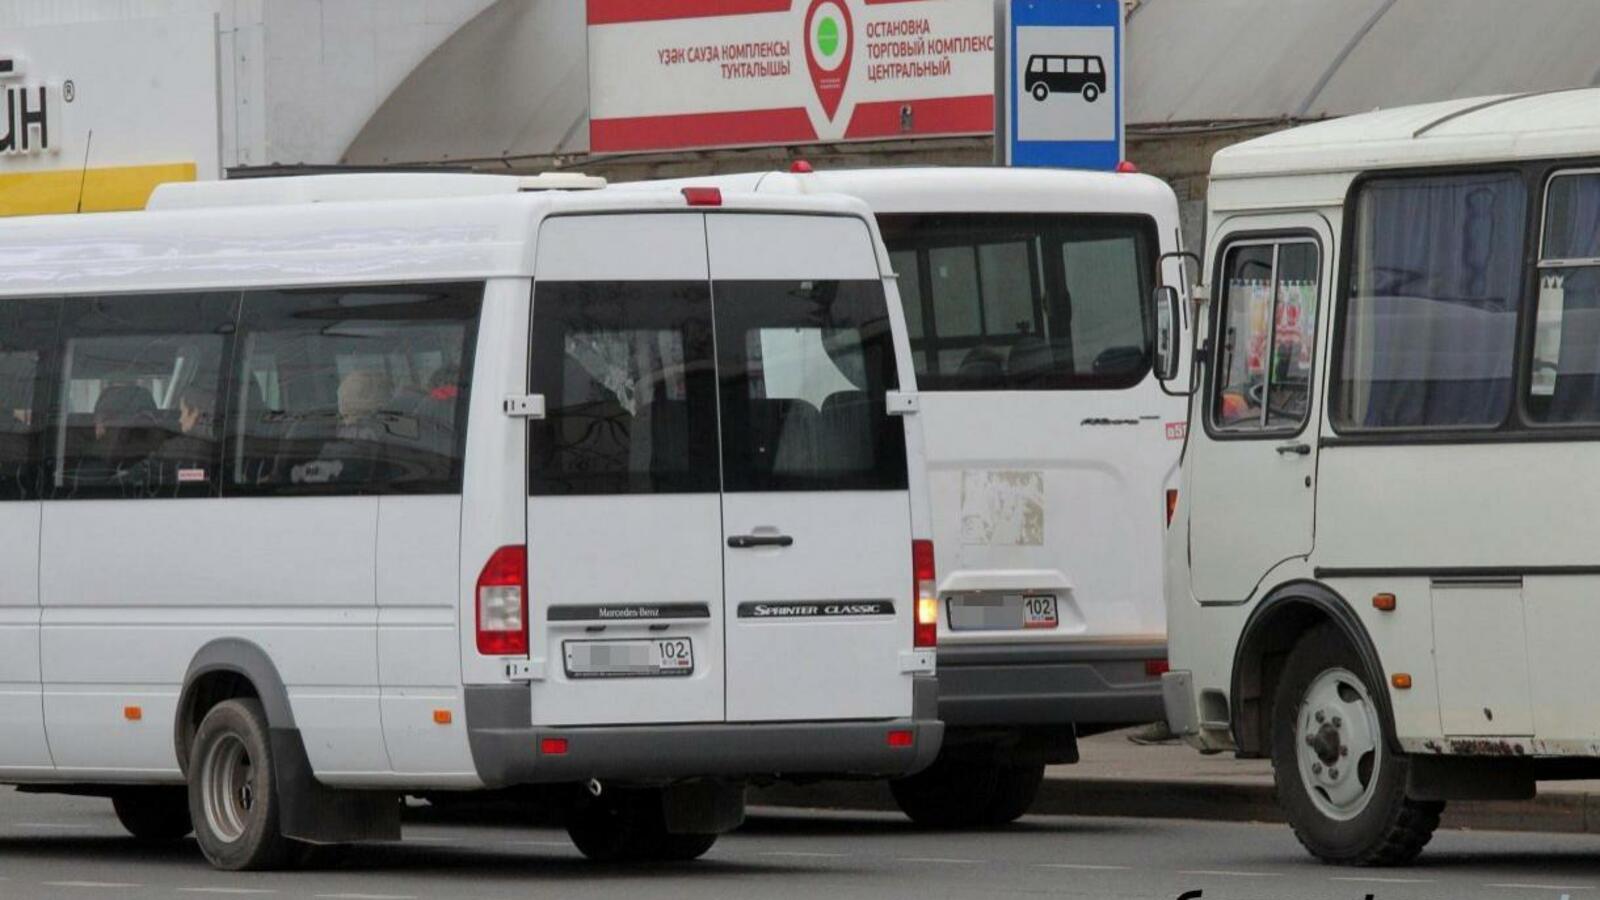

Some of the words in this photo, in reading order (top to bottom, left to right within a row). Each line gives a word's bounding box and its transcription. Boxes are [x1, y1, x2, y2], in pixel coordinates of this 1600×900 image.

[866, 19, 930, 38] ОСТАНОВКА
[721, 41, 791, 60] КОМПЛЕКСЫ
[866, 37, 925, 59] ТОРГОВЫЙ
[927, 35, 994, 55] КОМПЛЕКС
[867, 56, 951, 82] ЦЕНТРАЛЬНЫЙ
[824, 603, 881, 615] CLASSIC
[1025, 599, 1050, 615] 102
